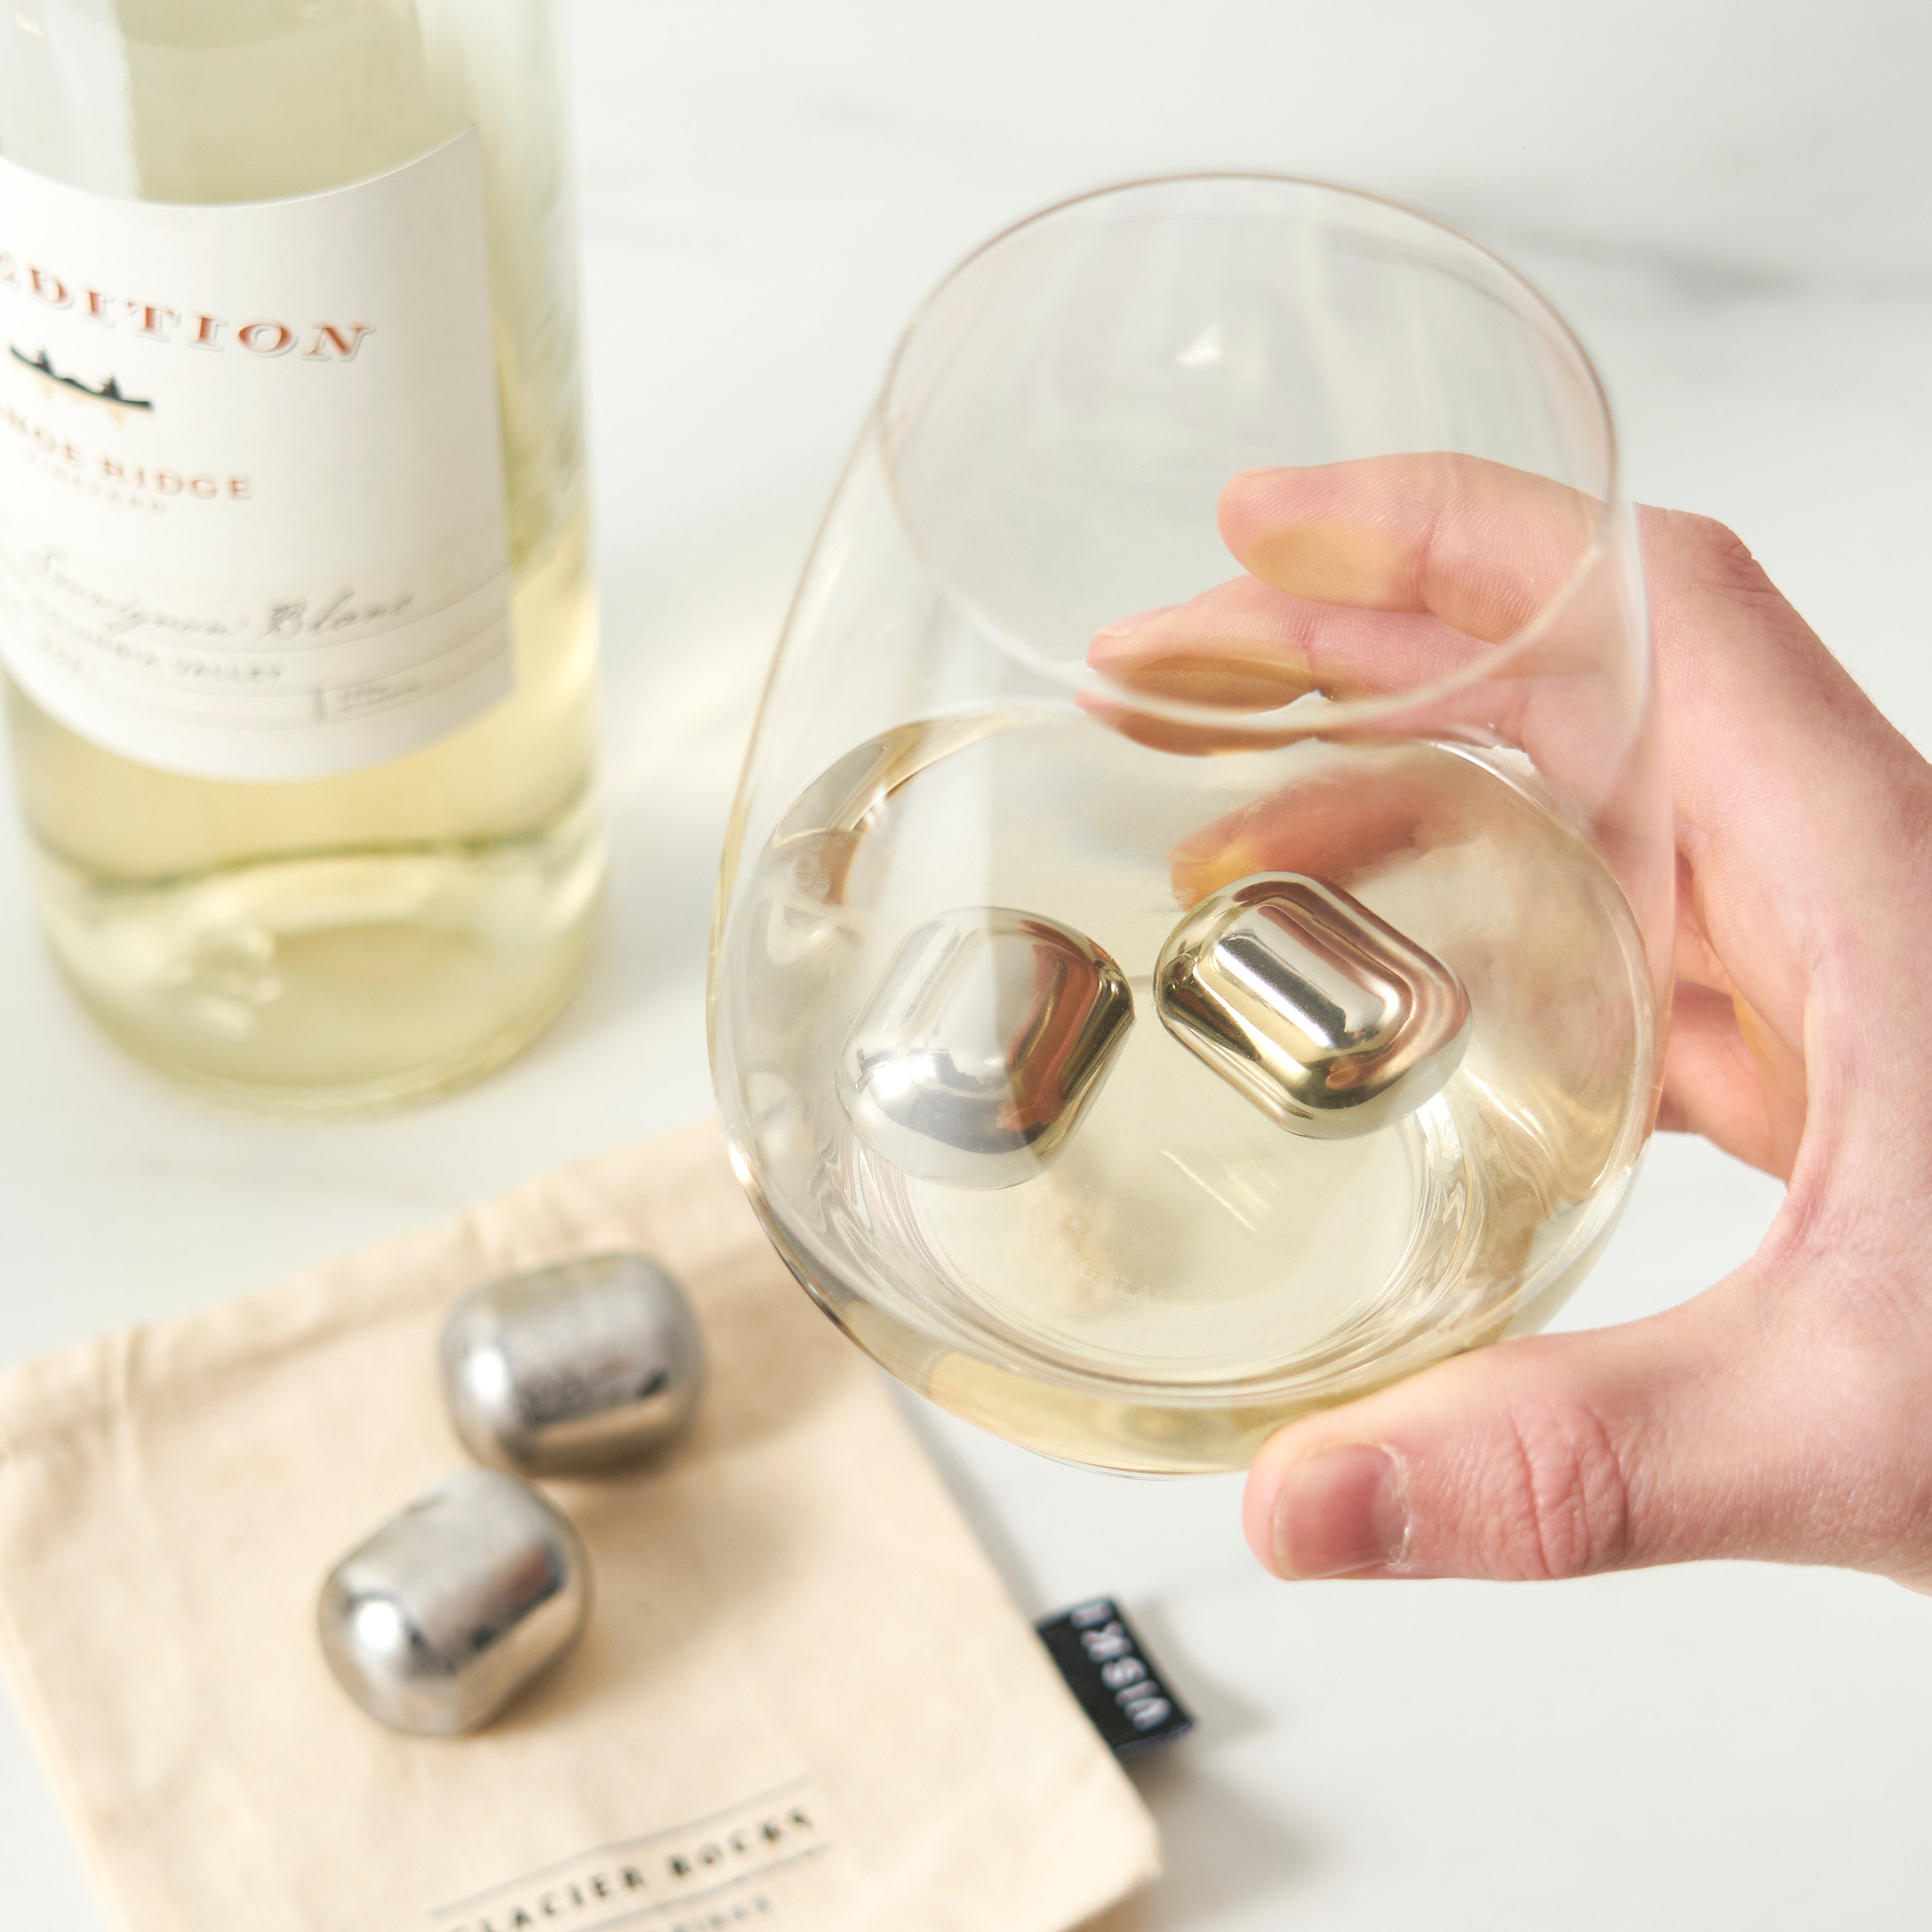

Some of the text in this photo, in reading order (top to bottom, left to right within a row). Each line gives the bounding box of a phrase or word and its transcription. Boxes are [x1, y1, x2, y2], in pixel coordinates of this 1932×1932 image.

[0, 402, 85, 470] NOE
[99, 454, 253, 502] RIDGE
[451, 1865, 645, 1932] LACIER
[667, 1806, 813, 1879] ROCKS
